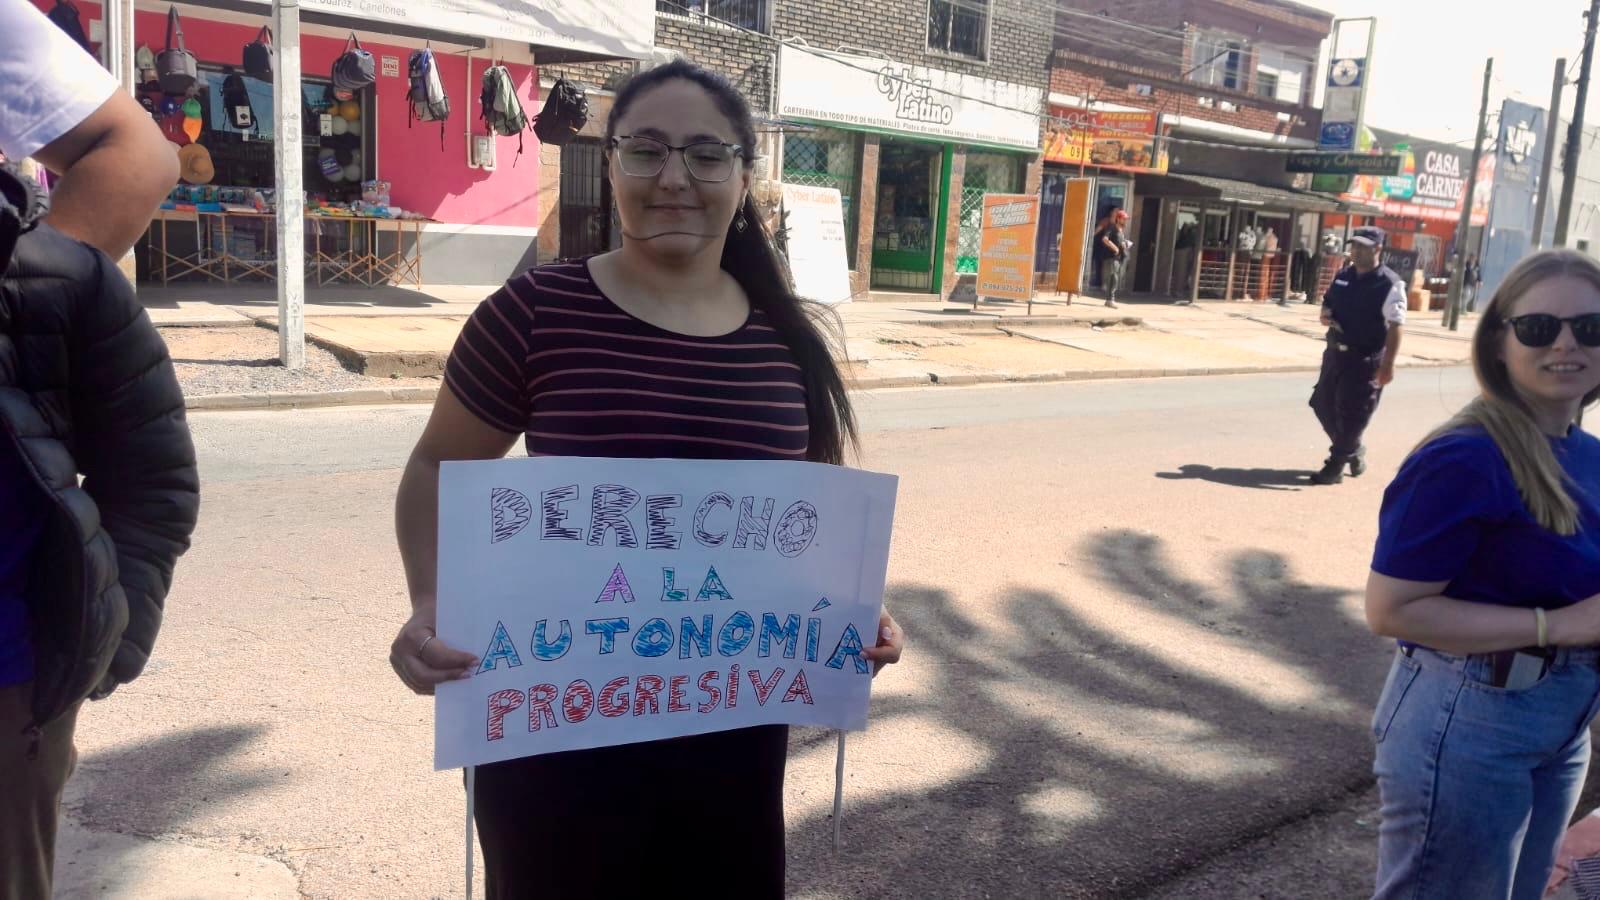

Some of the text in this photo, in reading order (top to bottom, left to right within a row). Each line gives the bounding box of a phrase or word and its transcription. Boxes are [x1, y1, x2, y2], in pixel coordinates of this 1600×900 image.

[359, 2, 407, 17] Canelones
[877, 66, 932, 101] Cyber
[828, 112, 845, 120] TODO
[845, 113, 858, 122] TIPO
[896, 96, 953, 125] Latino
[1425, 149, 1460, 177] CASA
[1416, 173, 1464, 199] CARNE
[595, 562, 734, 604] A LA
[475, 597, 870, 675] AUTONOMÍA
[486, 664, 814, 742] PROGRESIVA
